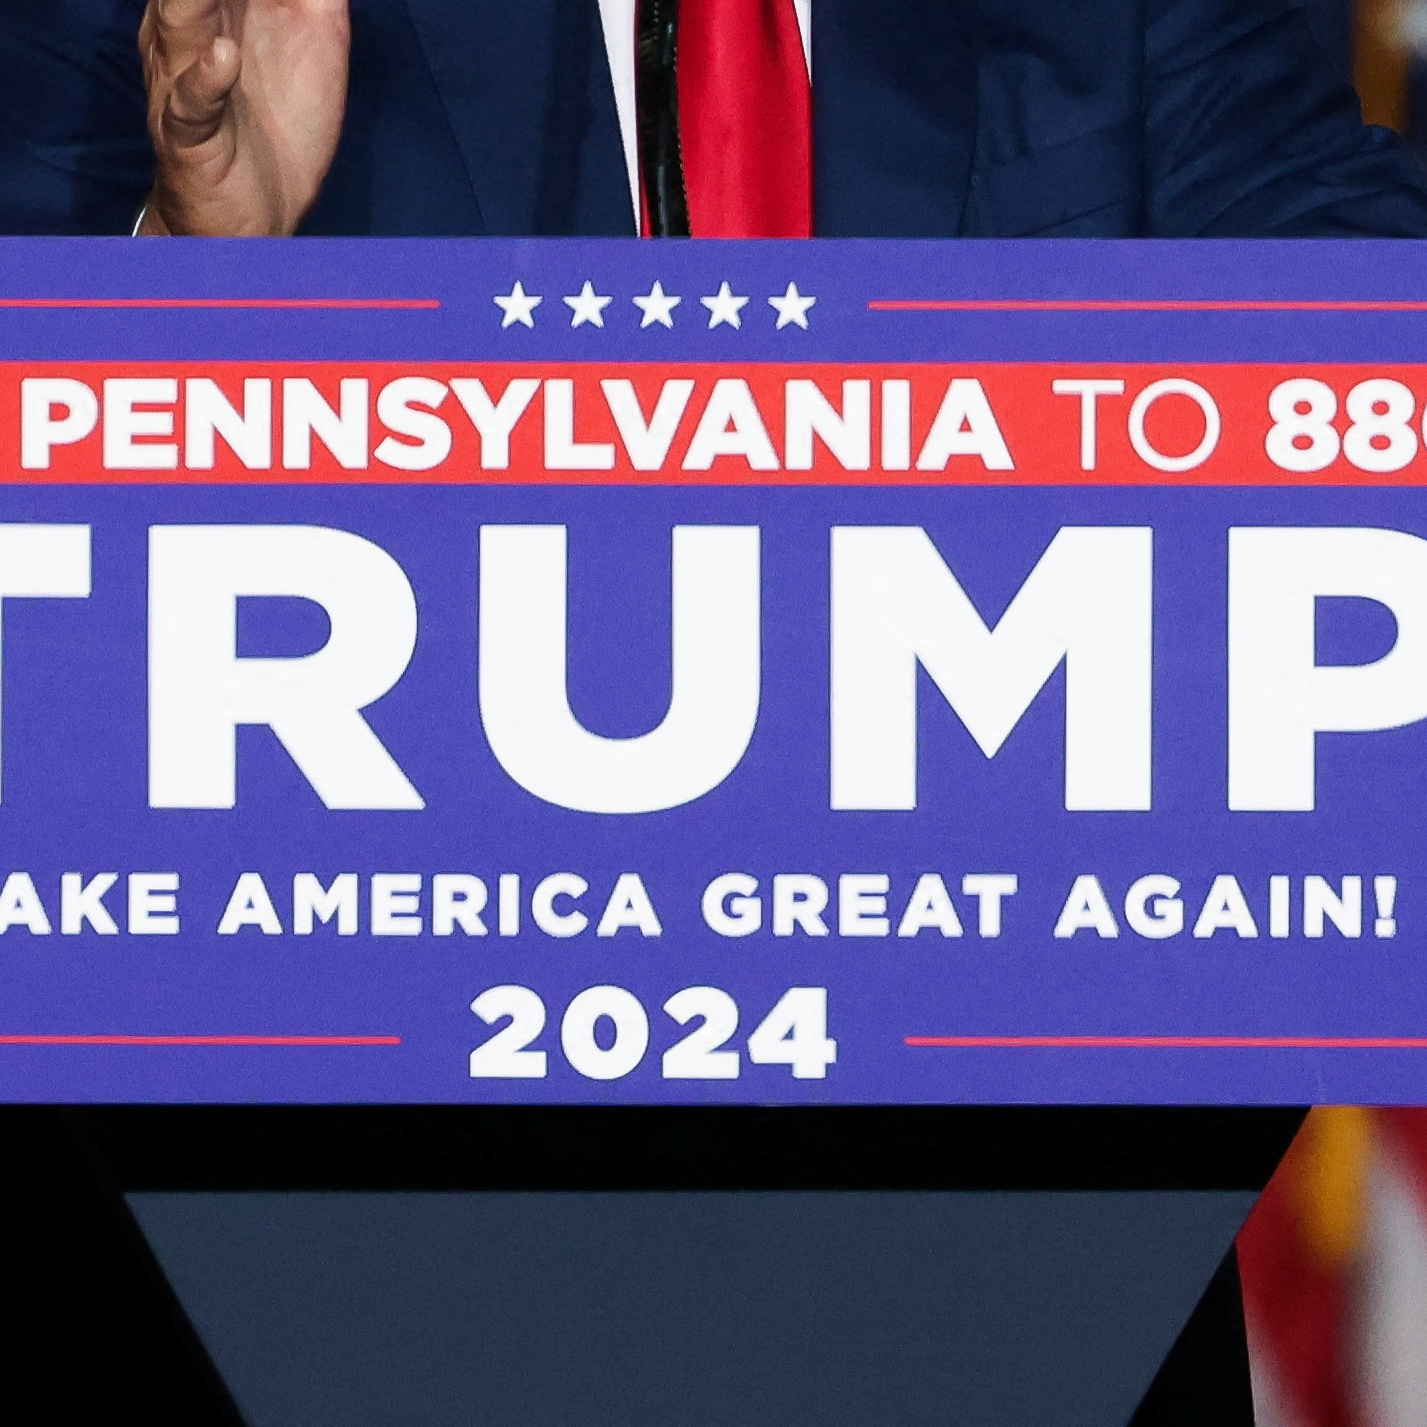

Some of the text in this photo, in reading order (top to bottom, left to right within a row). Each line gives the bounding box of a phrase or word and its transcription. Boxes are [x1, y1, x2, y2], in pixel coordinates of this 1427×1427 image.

[20, 375, 1016, 472] PENNSYLVANIA
[1051, 377, 1221, 473] TO
[217, 872, 663, 938] AMERICA
[701, 873, 1019, 939] GREAT
[1053, 874, 1398, 940] AGAIN!
[468, 984, 838, 1081] 2024
